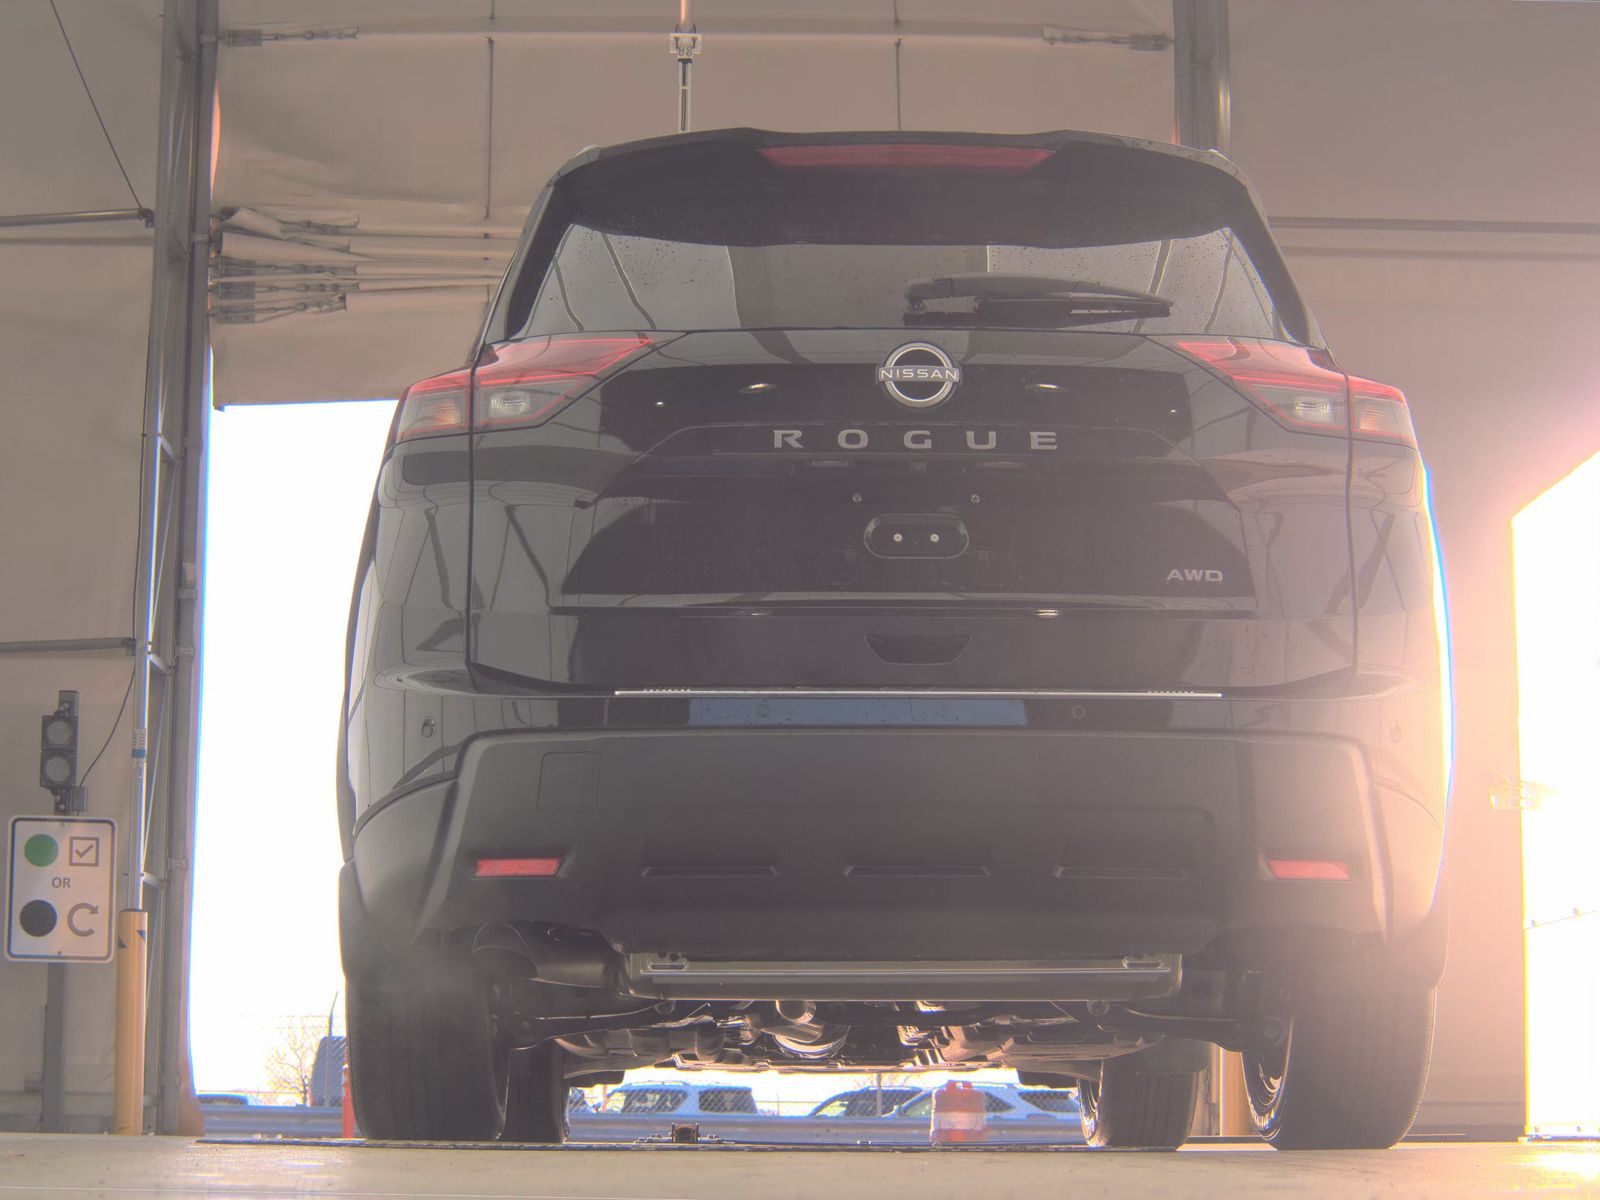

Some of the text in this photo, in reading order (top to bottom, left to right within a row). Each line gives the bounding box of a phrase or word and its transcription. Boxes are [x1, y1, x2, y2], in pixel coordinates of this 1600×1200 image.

[881, 368, 957, 380] NISSAN
[773, 429, 1058, 450] ROGUE
[1166, 568, 1223, 581] AWD
[52, 877, 71, 888] OR
